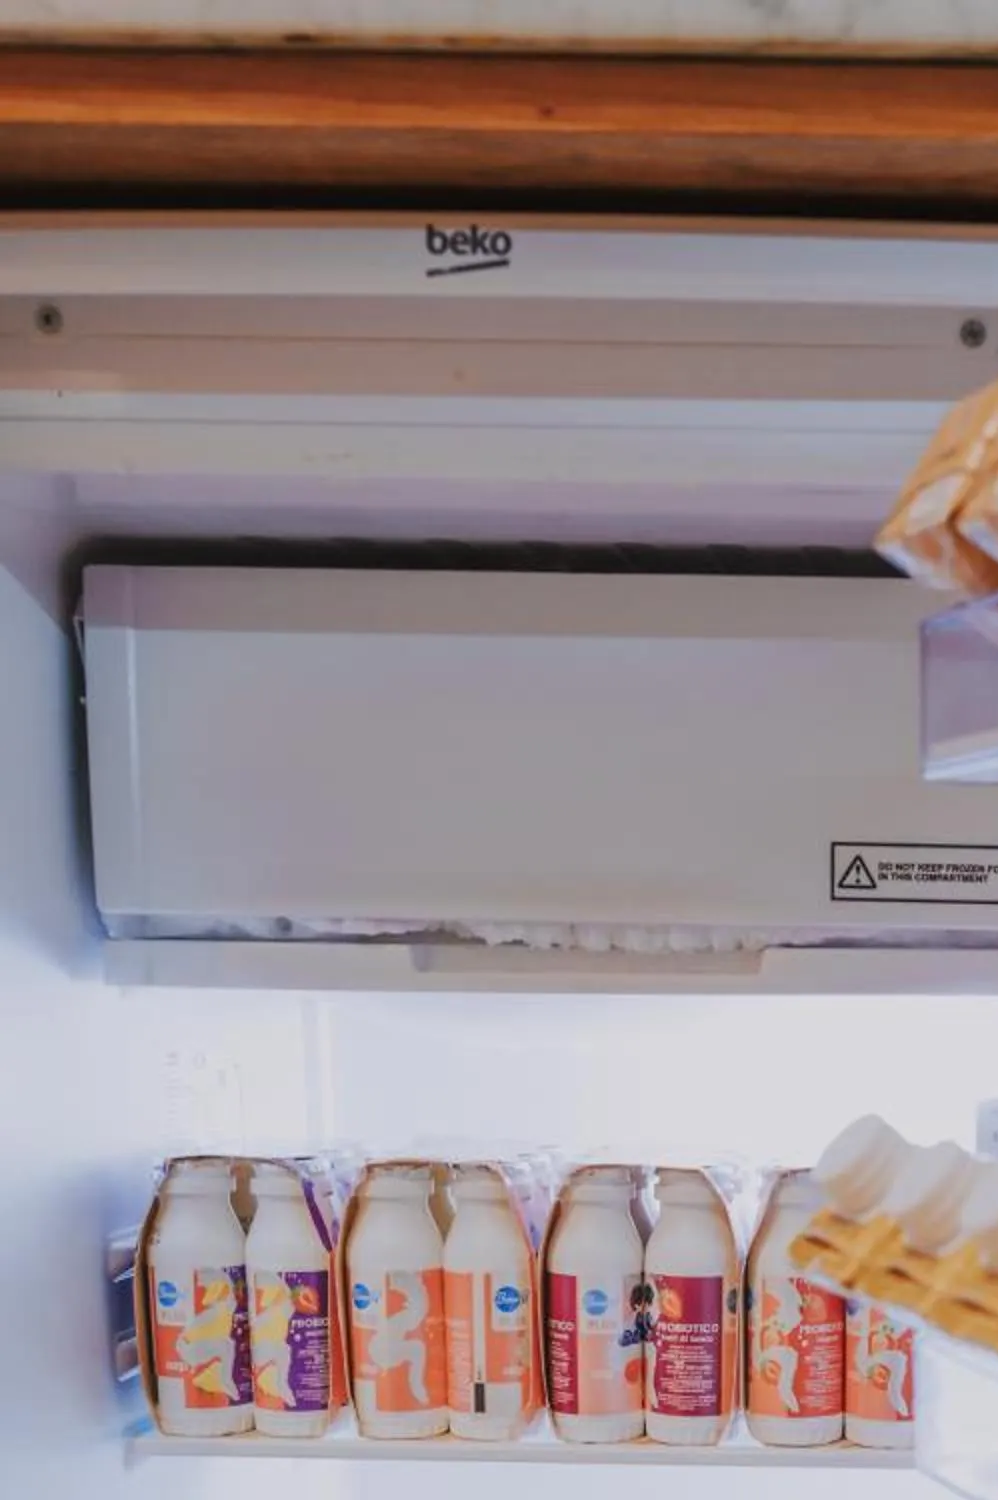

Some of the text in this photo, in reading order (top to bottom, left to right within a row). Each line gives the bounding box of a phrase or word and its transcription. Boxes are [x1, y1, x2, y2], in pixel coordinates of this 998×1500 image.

[426, 223, 513, 256] beko
[878, 861, 893, 871] DO
[896, 862, 915, 871] NOT
[917, 863, 944, 872] KEEP
[946, 863, 985, 873] FROZEN
[878, 871, 989, 883] IN THIS COMPARTMENT
